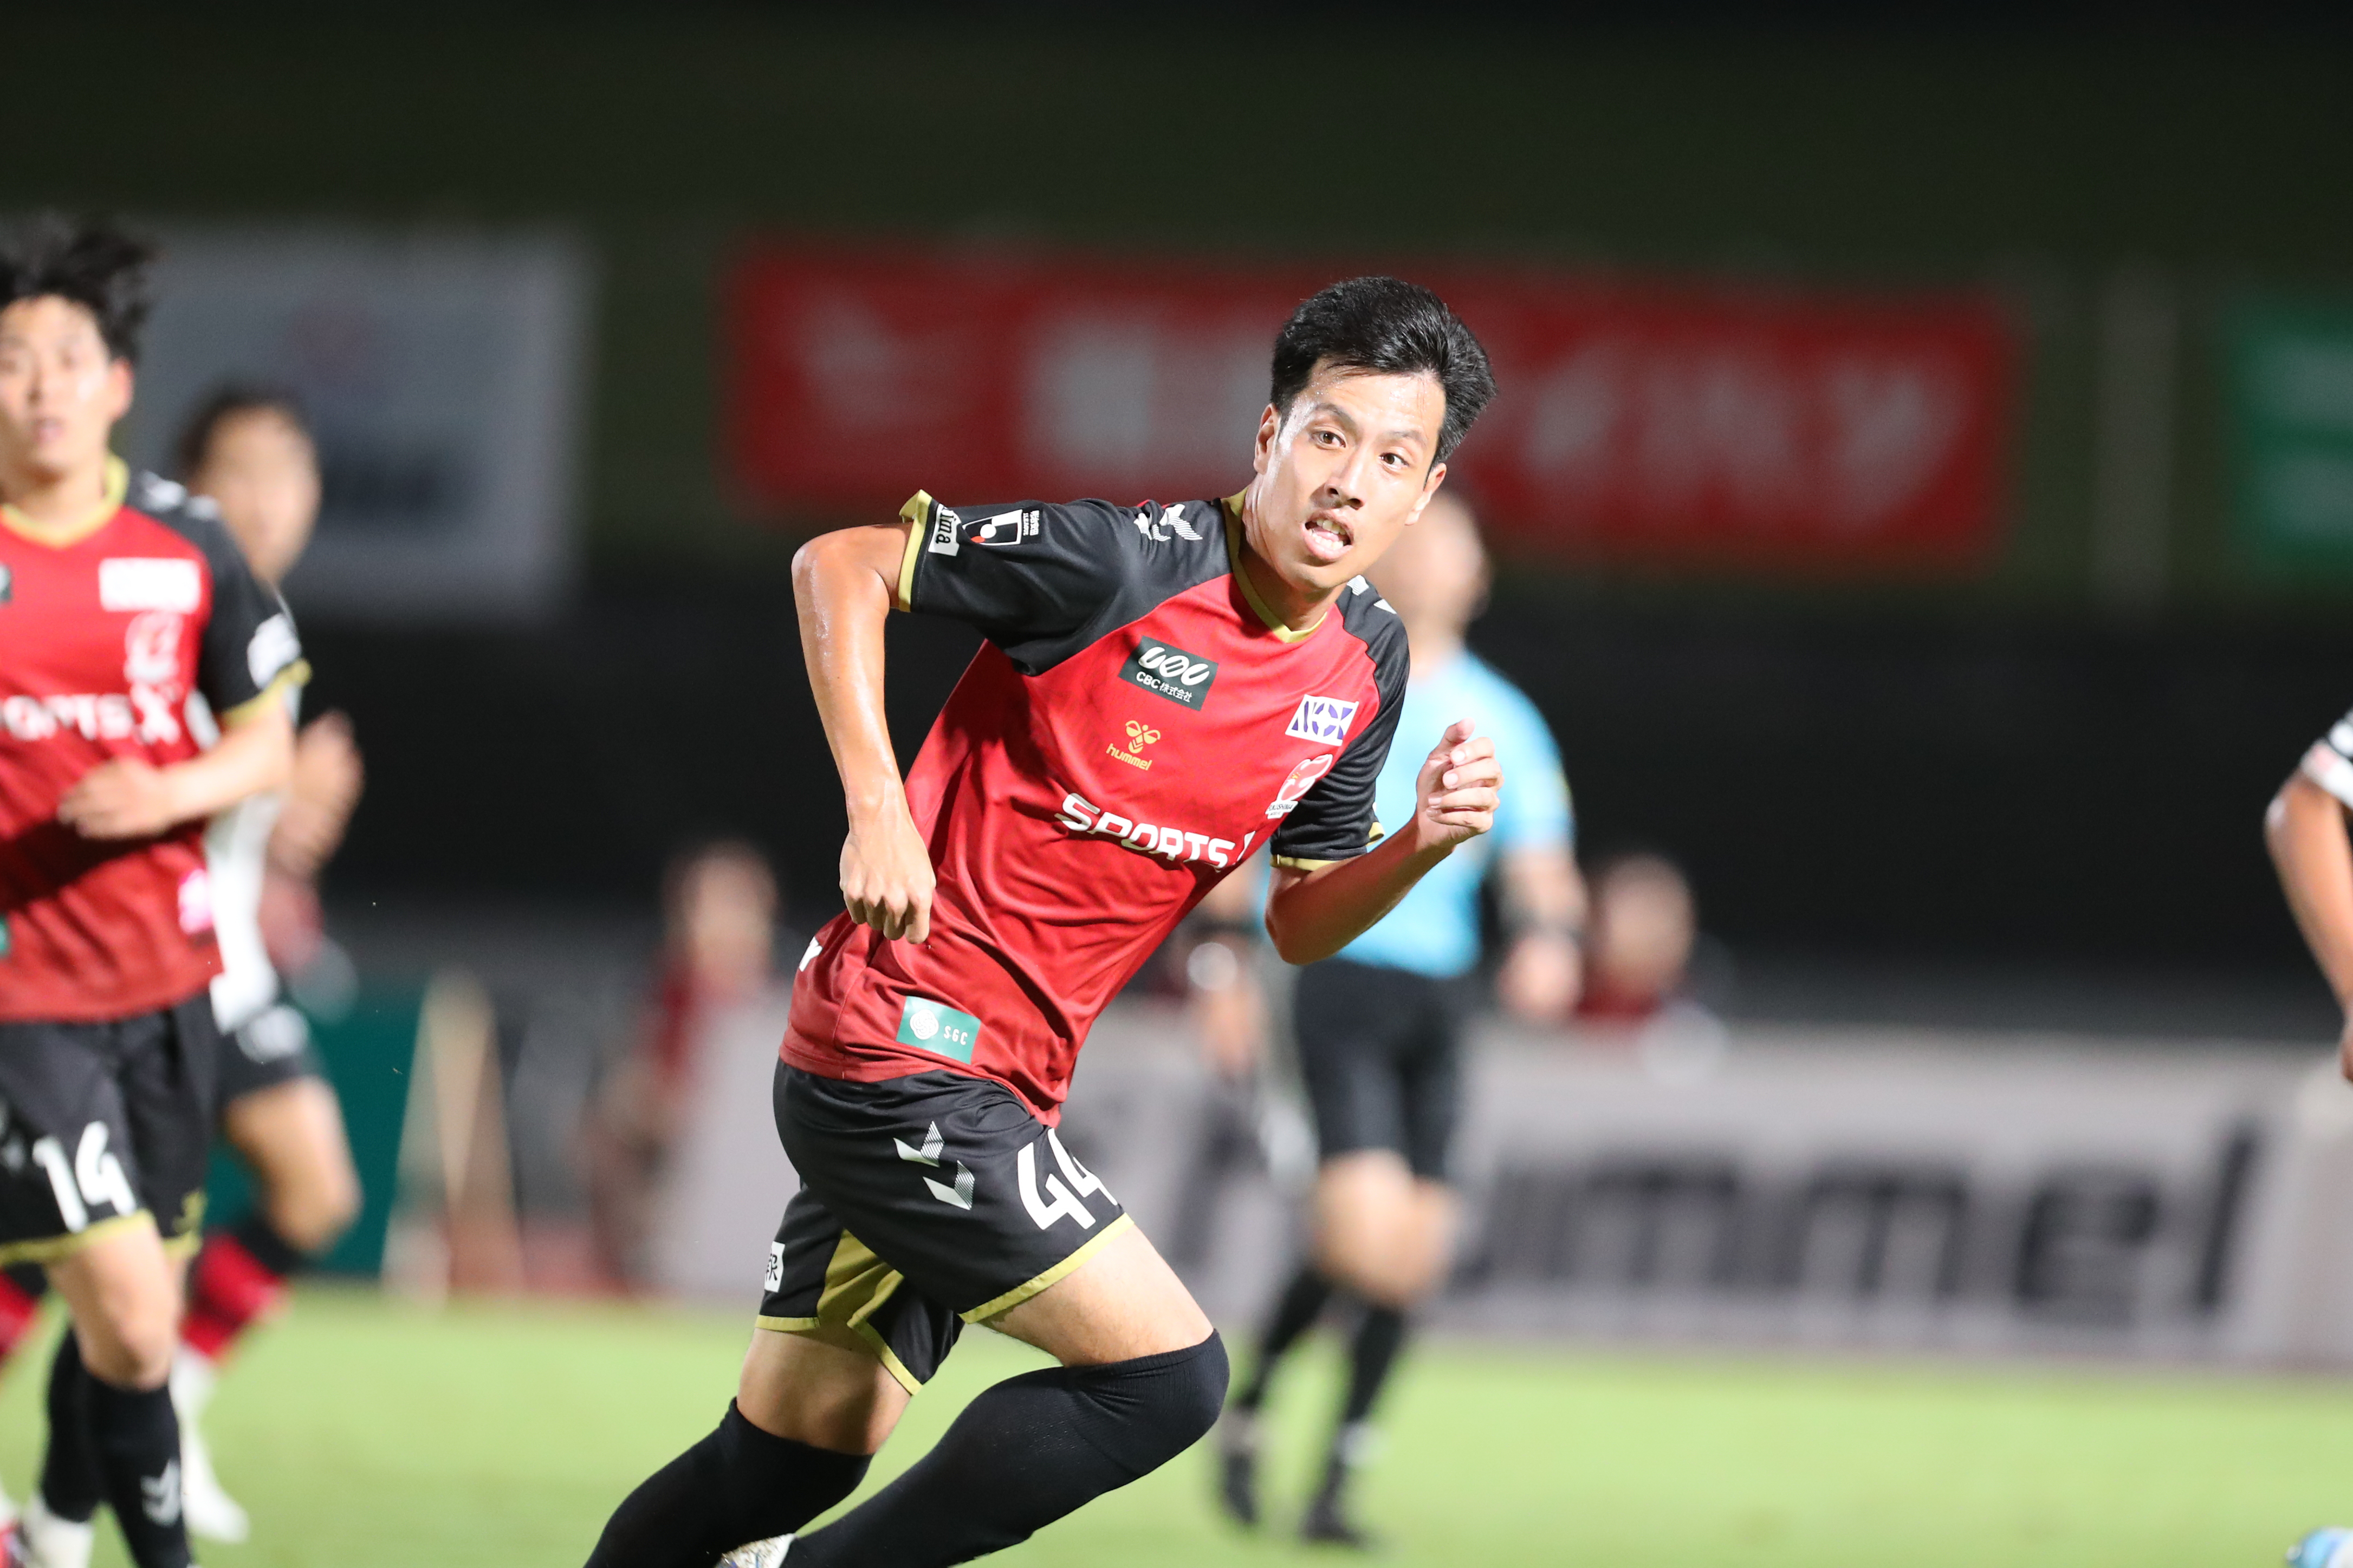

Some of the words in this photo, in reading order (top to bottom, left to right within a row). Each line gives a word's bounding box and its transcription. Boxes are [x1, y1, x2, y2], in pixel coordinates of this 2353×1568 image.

[1106, 743, 1152, 771] hummel
[1054, 792, 1236, 873] SPORTS
[31, 1120, 137, 1234] 14
[1017, 1127, 1118, 1231] 44
